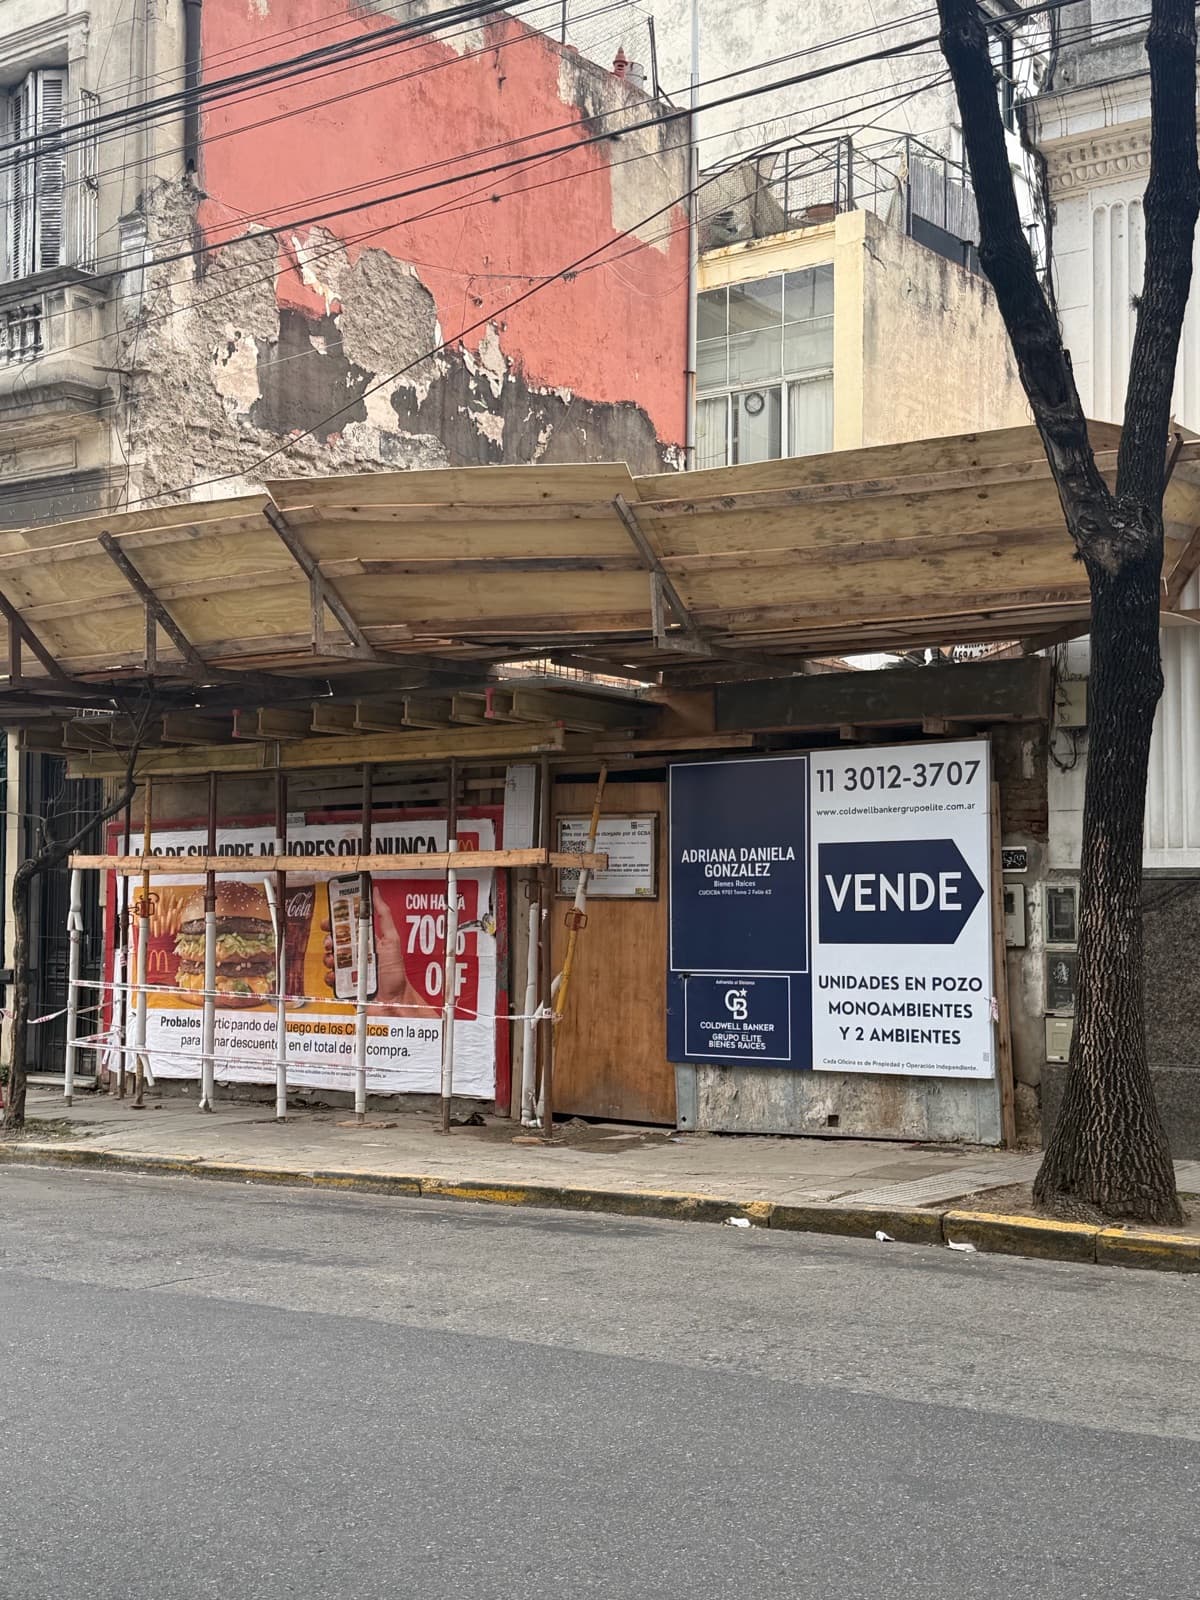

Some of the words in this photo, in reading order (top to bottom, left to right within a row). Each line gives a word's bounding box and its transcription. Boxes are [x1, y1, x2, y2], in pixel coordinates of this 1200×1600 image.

[816, 768, 834, 792] 11
[843, 760, 981, 792] 3012-3707
[816, 802, 976, 816] www.coldwellbankergrupoelite.com.ar
[681, 848, 737, 863] ADRIANA
[740, 846, 796, 861] DANIELA
[704, 863, 771, 877] GONZALEZ
[825, 872, 963, 912] VENDE
[406, 893, 428, 910] CON
[425, 961, 468, 997] OF
[818, 975, 899, 991] UNIDADES
[905, 976, 926, 991] EN
[932, 976, 983, 992] POZO
[828, 1002, 973, 1019] MONOAMBIENTES
[160, 1015, 201, 1028] Probalos
[286, 1022, 312, 1036] uego
[314, 1022, 326, 1034] de
[328, 1022, 343, 1035] los
[391, 1027, 404, 1038] en
[407, 1025, 415, 1038] la
[418, 1028, 439, 1042] app
[700, 1021, 741, 1031] COLDWELL
[743, 1022, 774, 1032] BANKER
[712, 1033, 739, 1041] GRUPO
[741, 1034, 762, 1043] ELITE
[839, 1026, 849, 1041] Y
[855, 1027, 865, 1041] 2
[869, 1027, 961, 1045] AMBIENTES
[181, 1035, 201, 1047] para
[289, 1042, 301, 1052] en
[303, 1040, 312, 1052] el
[314, 1041, 337, 1053] total
[340, 1042, 352, 1054] de
[366, 1046, 411, 1059] compra.
[709, 1040, 735, 1049] BIENES
[838, 1058, 856, 1066] Oficina
[864, 1059, 871, 1067] de
[872, 1060, 901, 1069] Propiedad
